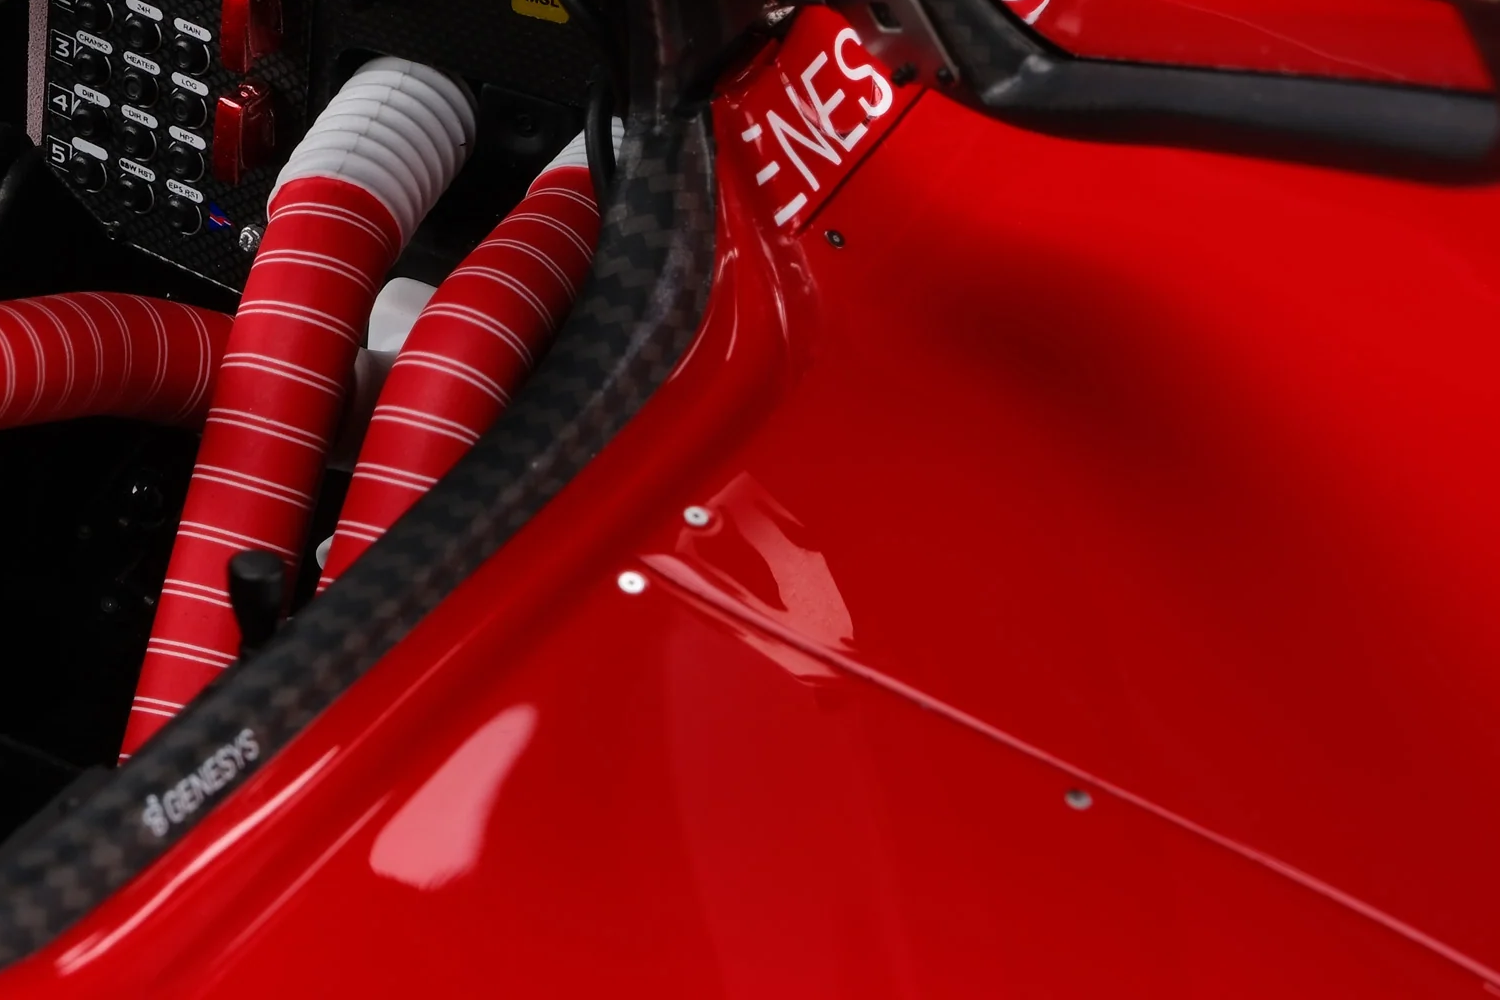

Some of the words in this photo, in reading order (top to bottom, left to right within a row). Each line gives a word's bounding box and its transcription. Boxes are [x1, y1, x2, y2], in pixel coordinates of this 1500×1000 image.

[183, 23, 201, 36] RAIN
[55, 37, 70, 58] 3
[126, 54, 155, 71] HEATER
[181, 78, 197, 90] LOG
[52, 94, 68, 112] 4
[51, 143, 66, 163] 5
[163, 728, 260, 824] GENESYS
